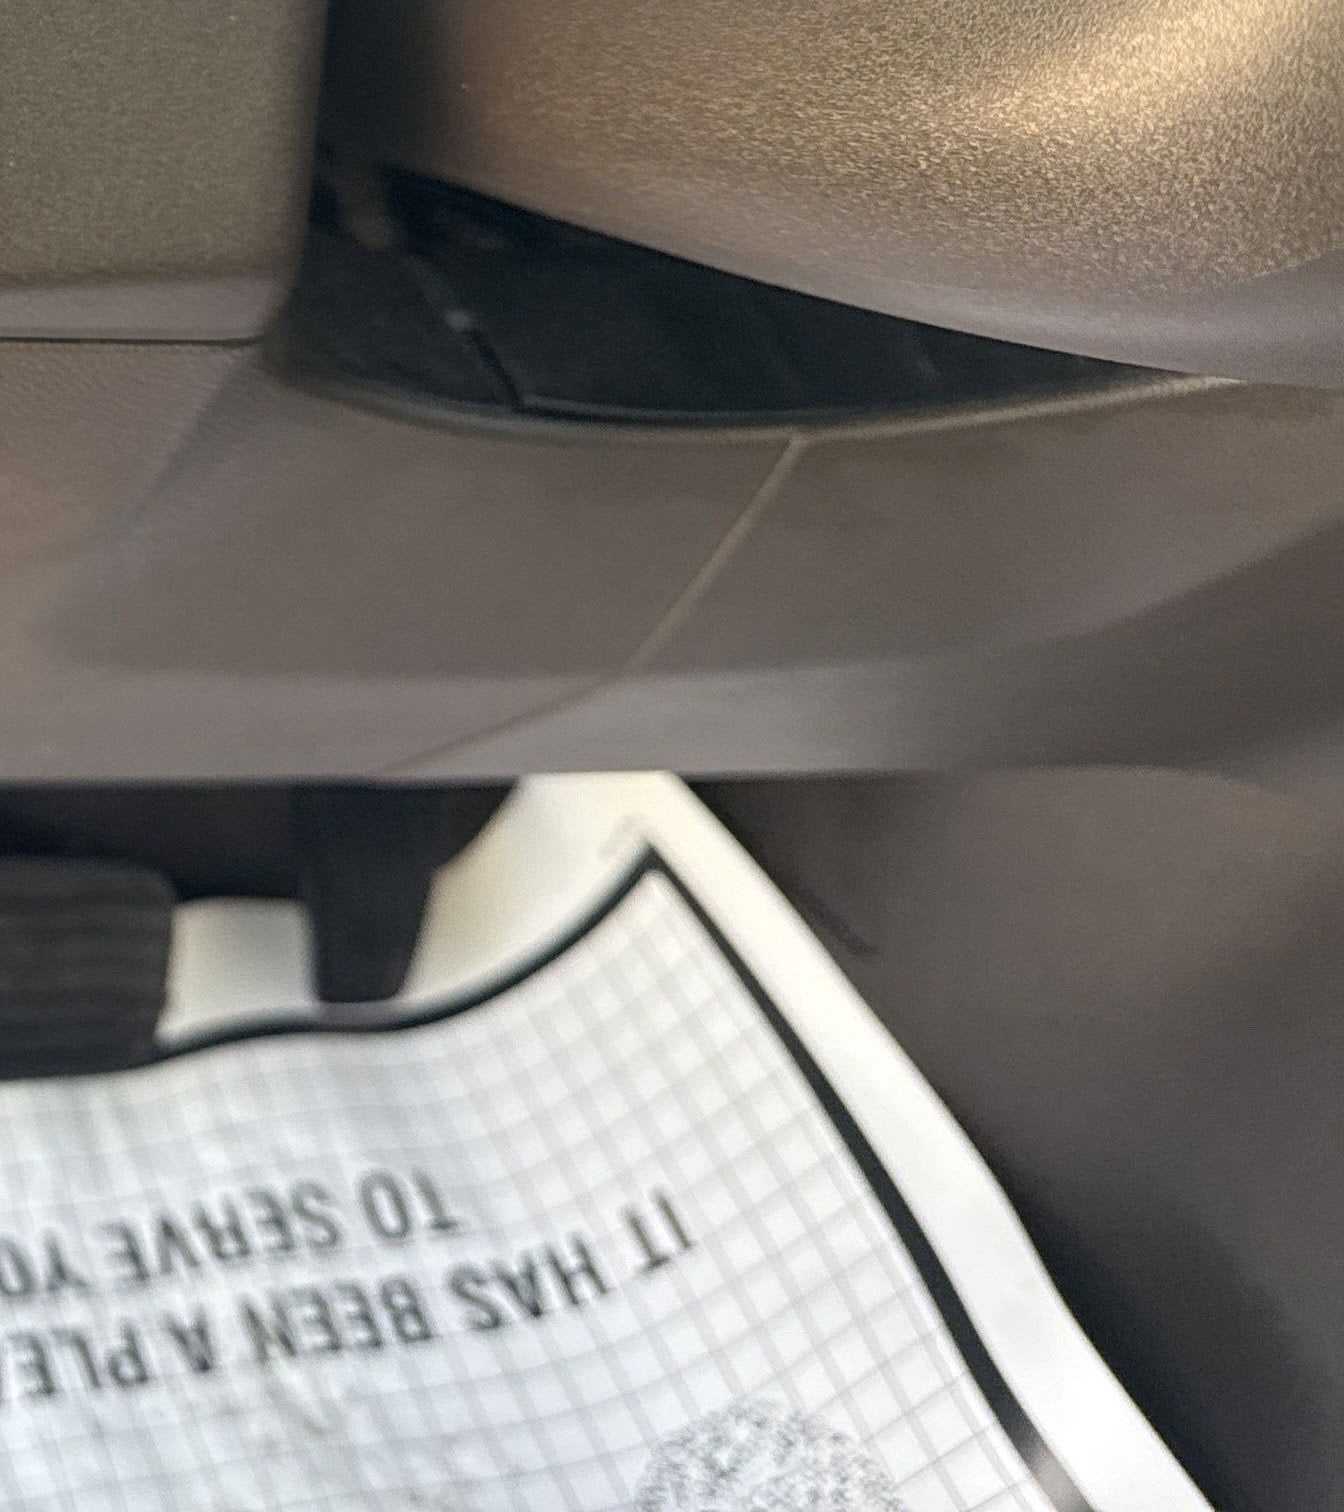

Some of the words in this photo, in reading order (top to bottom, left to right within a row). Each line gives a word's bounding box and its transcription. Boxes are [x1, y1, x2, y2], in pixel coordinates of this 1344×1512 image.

[100, 1178, 341, 1284] SERVE
[358, 1168, 459, 1243] TO
[622, 1188, 694, 1271] IT
[237, 1274, 433, 1365] BEEN
[448, 1231, 609, 1330] HAS
[165, 1303, 213, 1373] A
